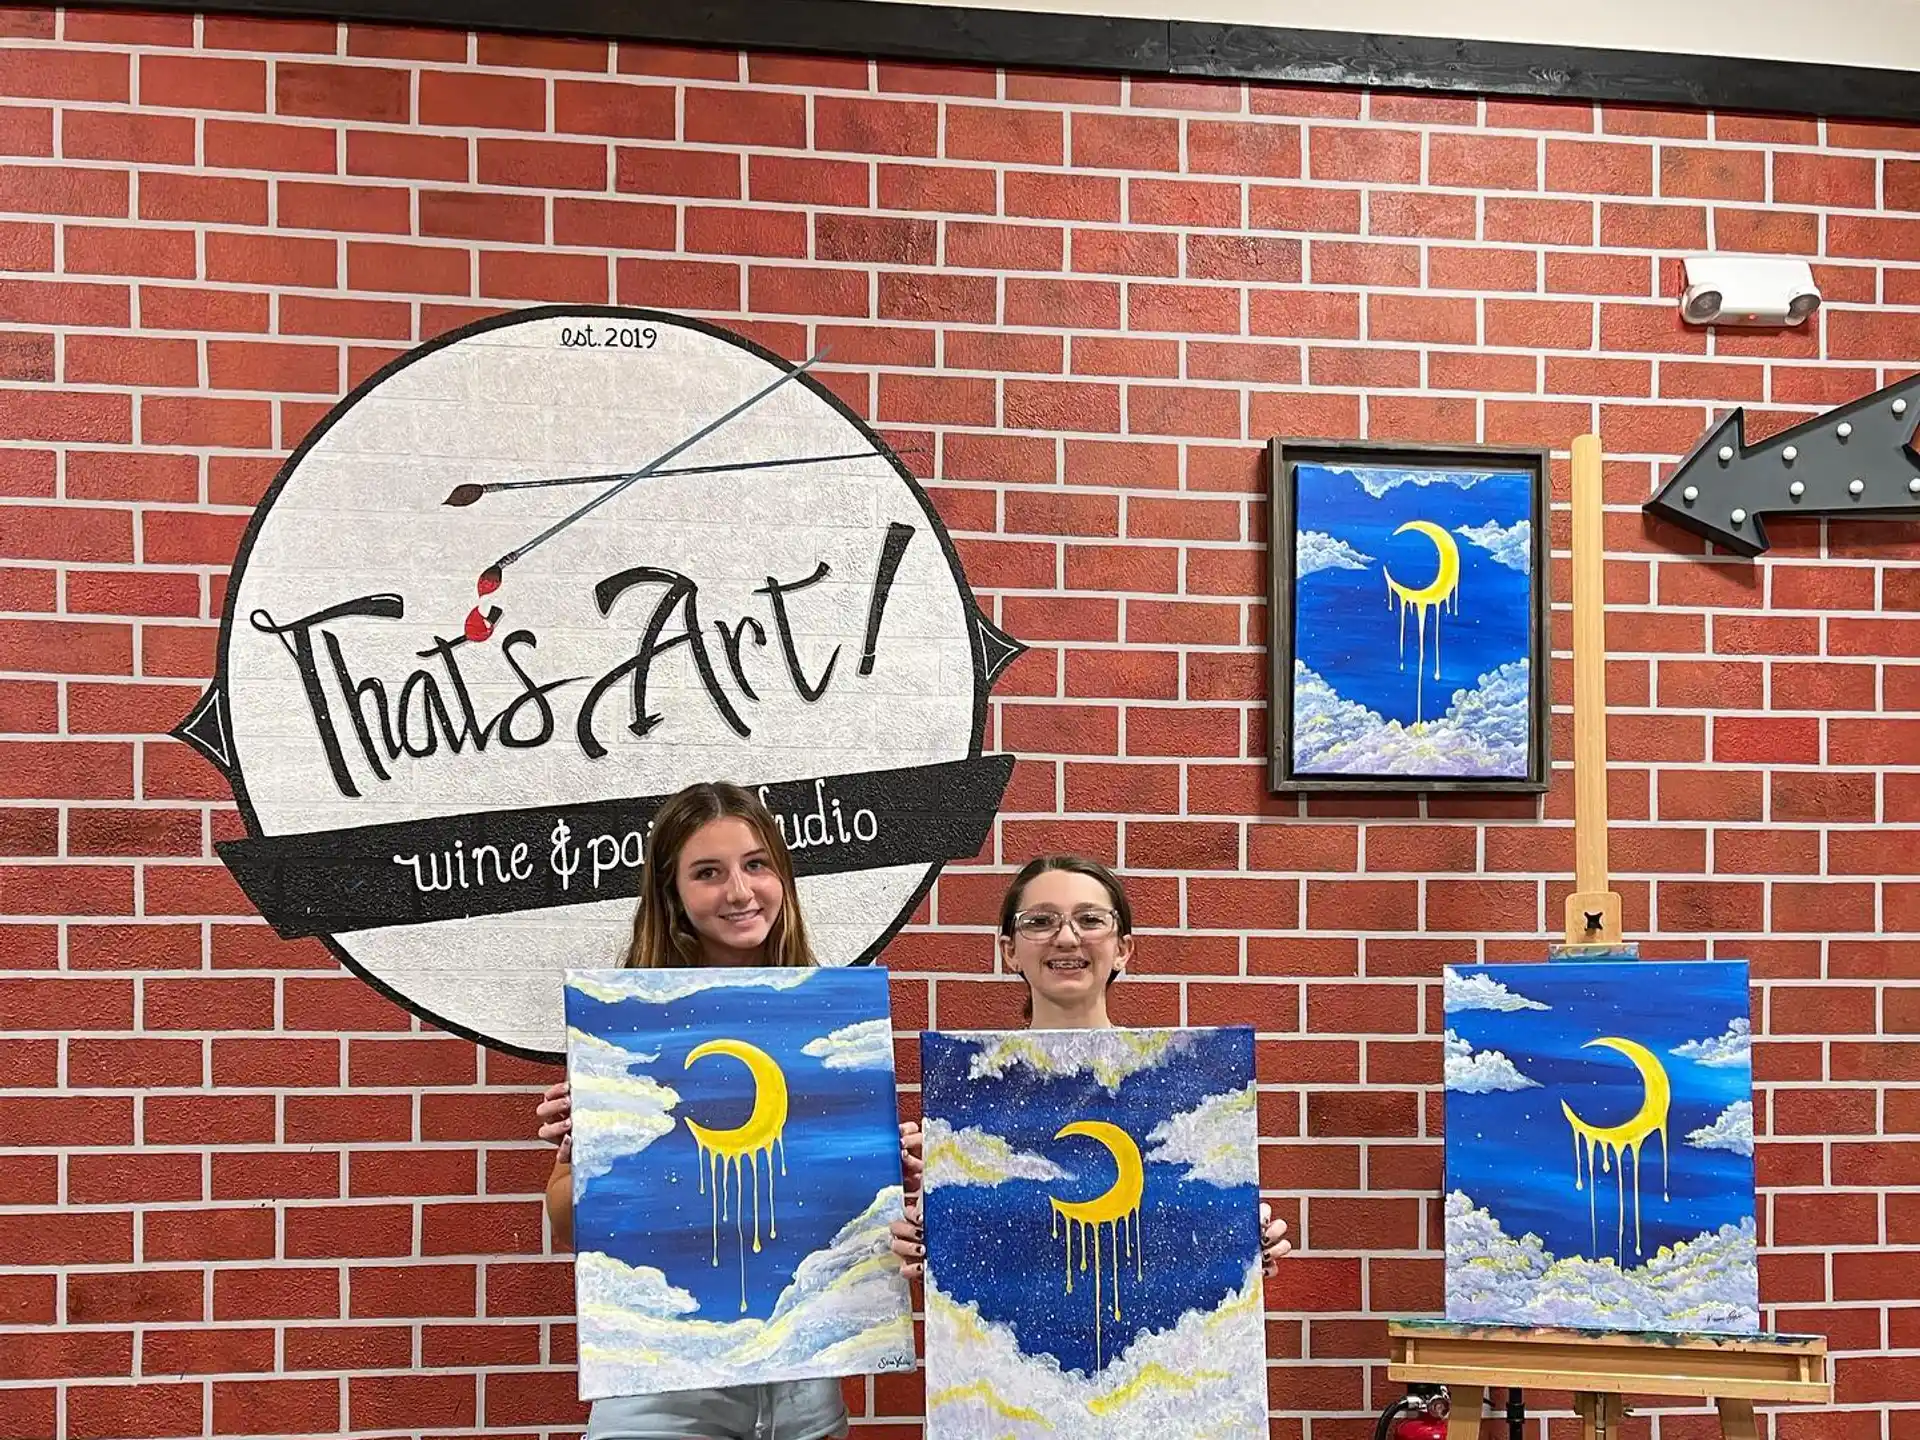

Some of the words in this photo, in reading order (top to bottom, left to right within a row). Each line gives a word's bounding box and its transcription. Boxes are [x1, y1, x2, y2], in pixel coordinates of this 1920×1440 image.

[560, 324, 601, 347] est.
[604, 327, 657, 348] 2019
[393, 840, 534, 892] wine
[550, 818, 580, 890] &
[758, 778, 878, 850] udio
